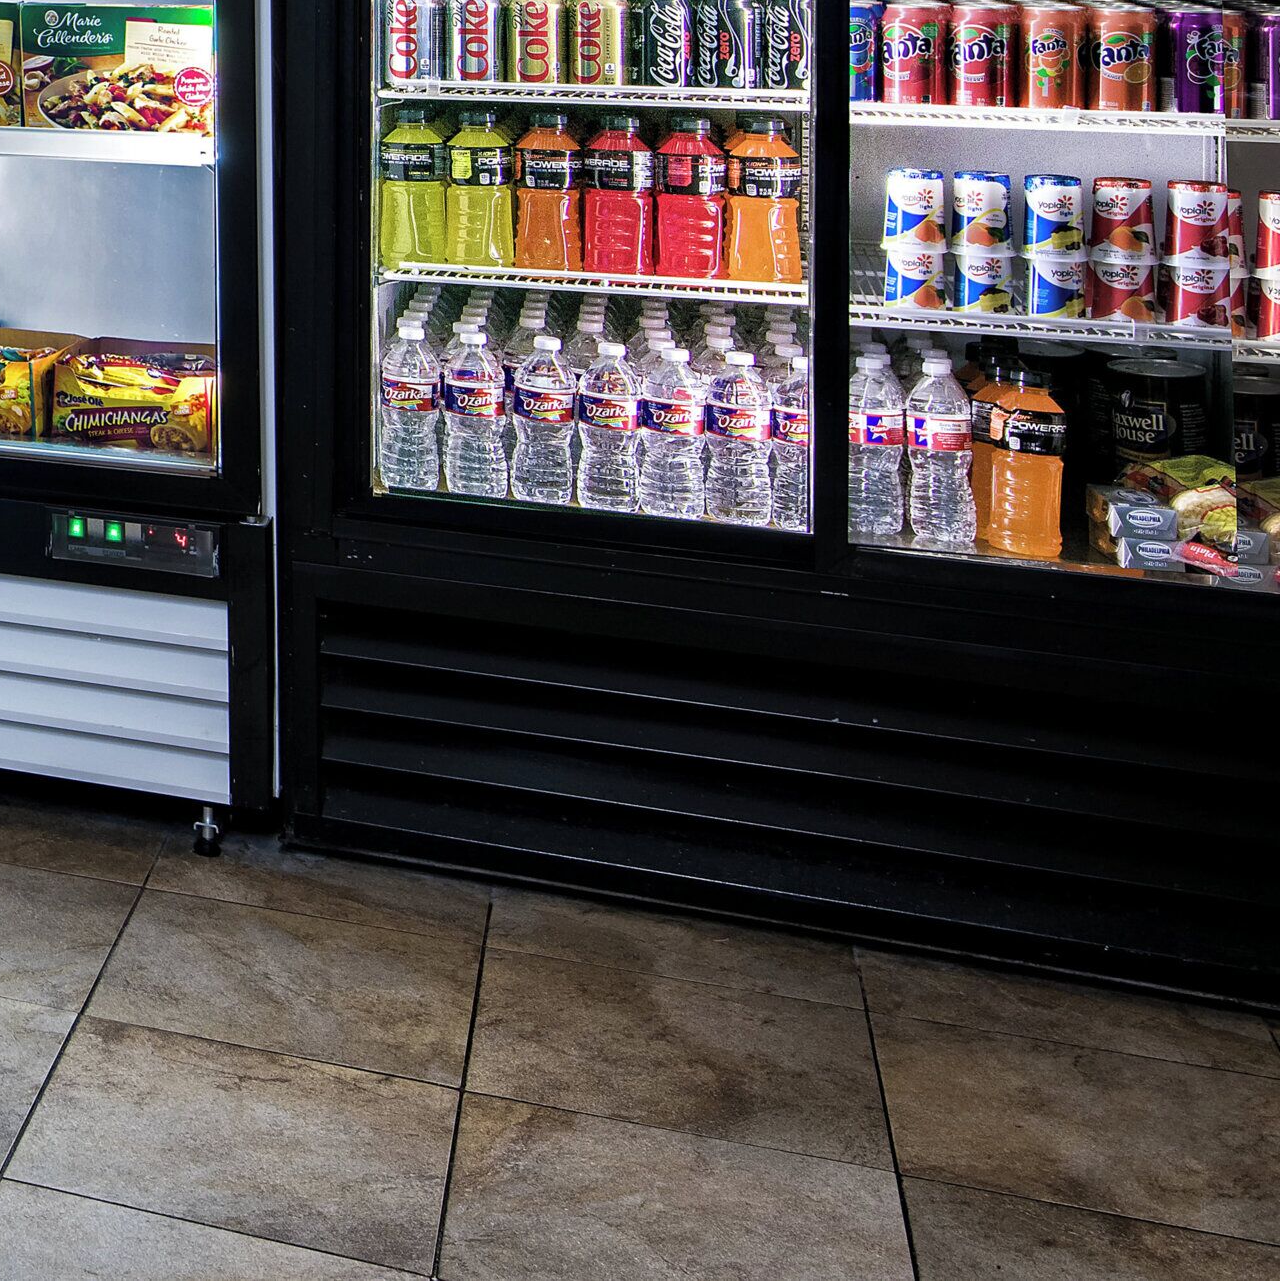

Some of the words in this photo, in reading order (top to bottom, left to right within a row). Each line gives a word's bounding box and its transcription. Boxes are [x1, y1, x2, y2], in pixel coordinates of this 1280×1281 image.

[56, 12, 101, 32] Marie
[33, 28, 113, 48] Callender's
[458, 0, 488, 80] Coke
[518, 1, 549, 83] Coke
[651, 0, 683, 88] Coca-Cola
[697, 3, 718, 86] Coca-Cola
[719, 30, 730, 61] zero
[768, 1, 789, 88] Coca-Cola
[789, 31, 801, 62] zero
[1031, 36, 1067, 57] Fanta
[1038, 200, 1068, 210] Yoplait
[1095, 199, 1123, 211] Yoplait
[1194, 215, 1217, 223] original
[1101, 270, 1135, 282] Yoplait
[1176, 272, 1205, 284] Yoplait
[68, 394, 88, 403] José
[88, 396, 104, 407] Olé
[384, 388, 425, 402] Ozarka
[523, 397, 565, 412] Ozarka
[586, 403, 630, 418] Ozarka
[65, 410, 168, 432] CHIMICHANGAS
[1128, 513, 1161, 523] PHILADELPHIA
[1137, 546, 1171, 555] PHILADELPHIA
[1190, 544, 1217, 559] Plain
